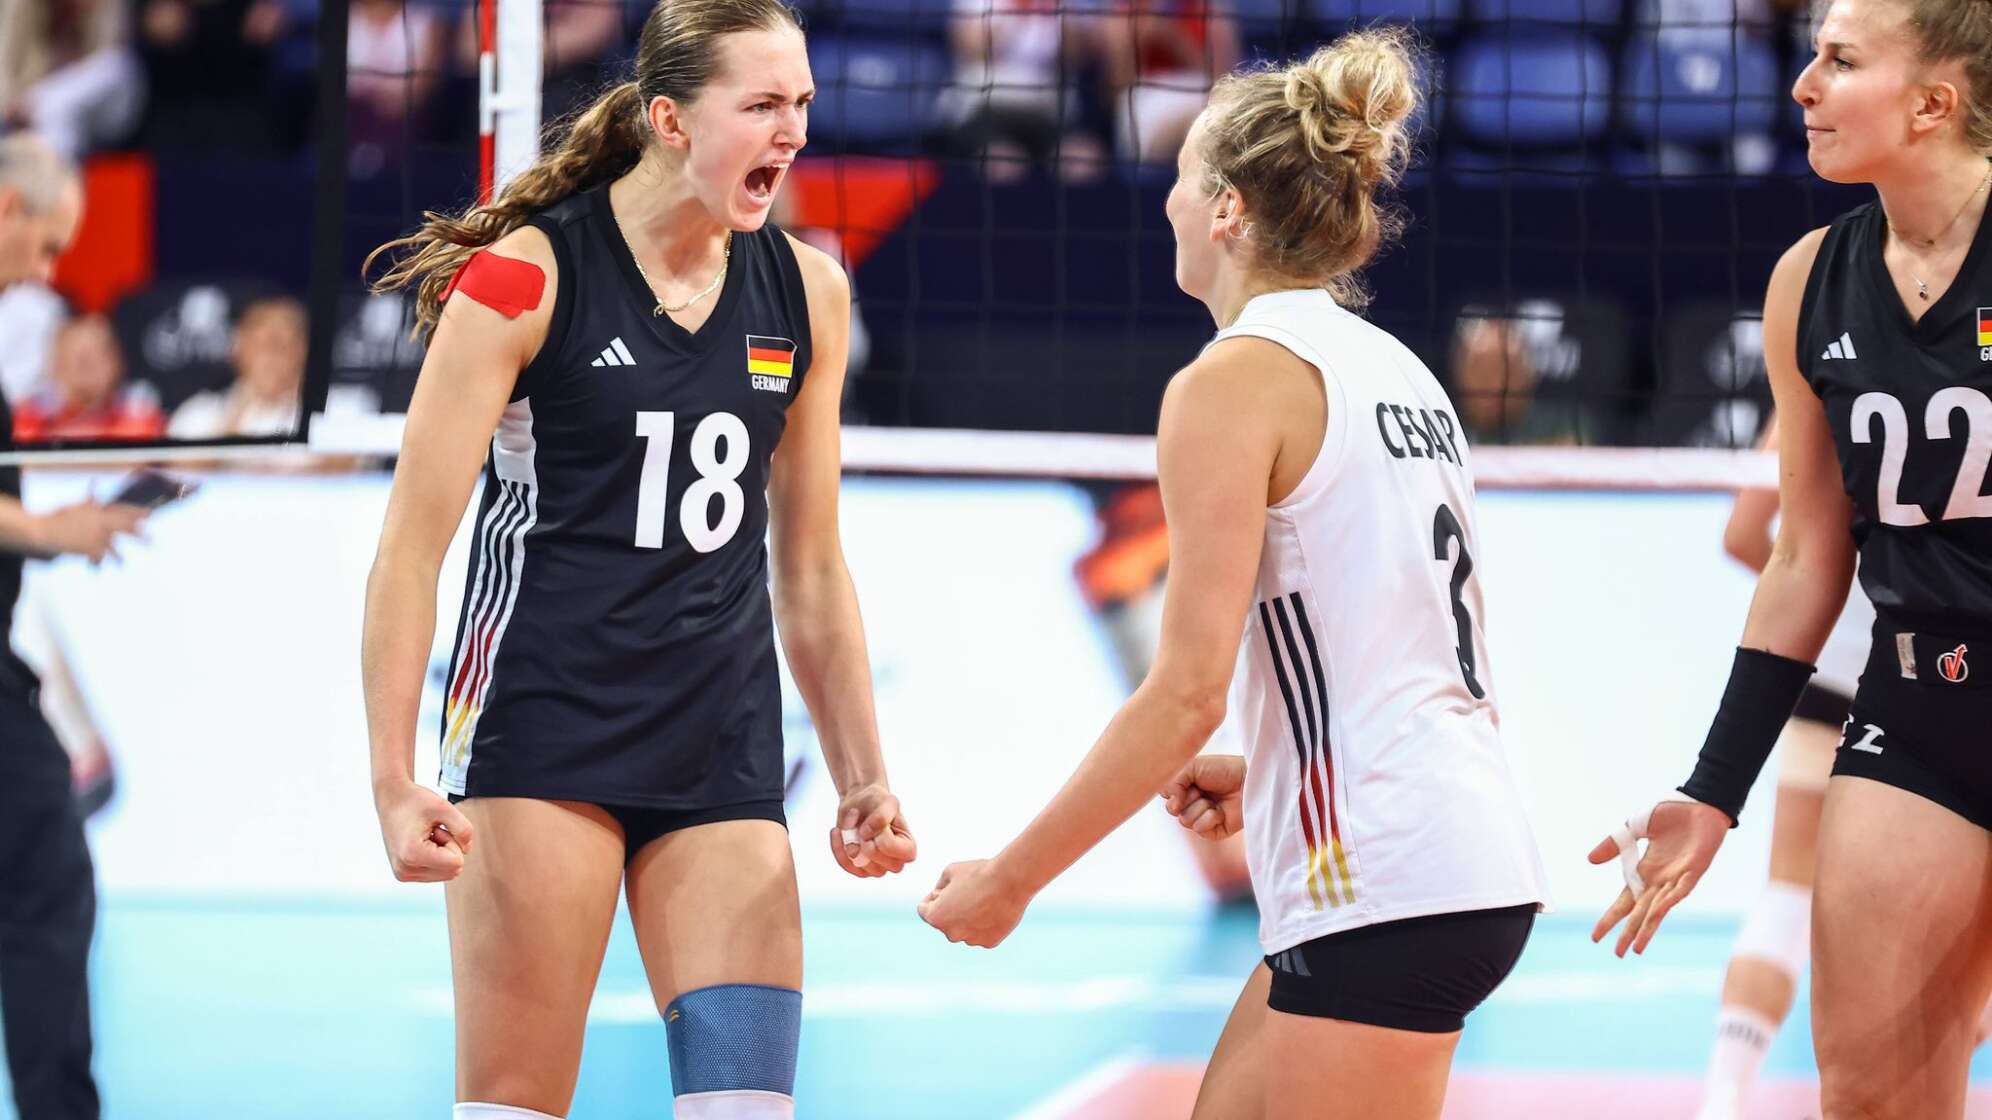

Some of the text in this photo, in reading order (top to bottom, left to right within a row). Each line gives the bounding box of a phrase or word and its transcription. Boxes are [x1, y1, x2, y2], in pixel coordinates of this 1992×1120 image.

[752, 374, 790, 394] GERMANY
[1376, 402, 1463, 467] CESAR
[634, 411, 750, 553] 18
[1850, 386, 1992, 527] 22
[1433, 503, 1486, 700] 3
[1839, 712, 1886, 755] 2
